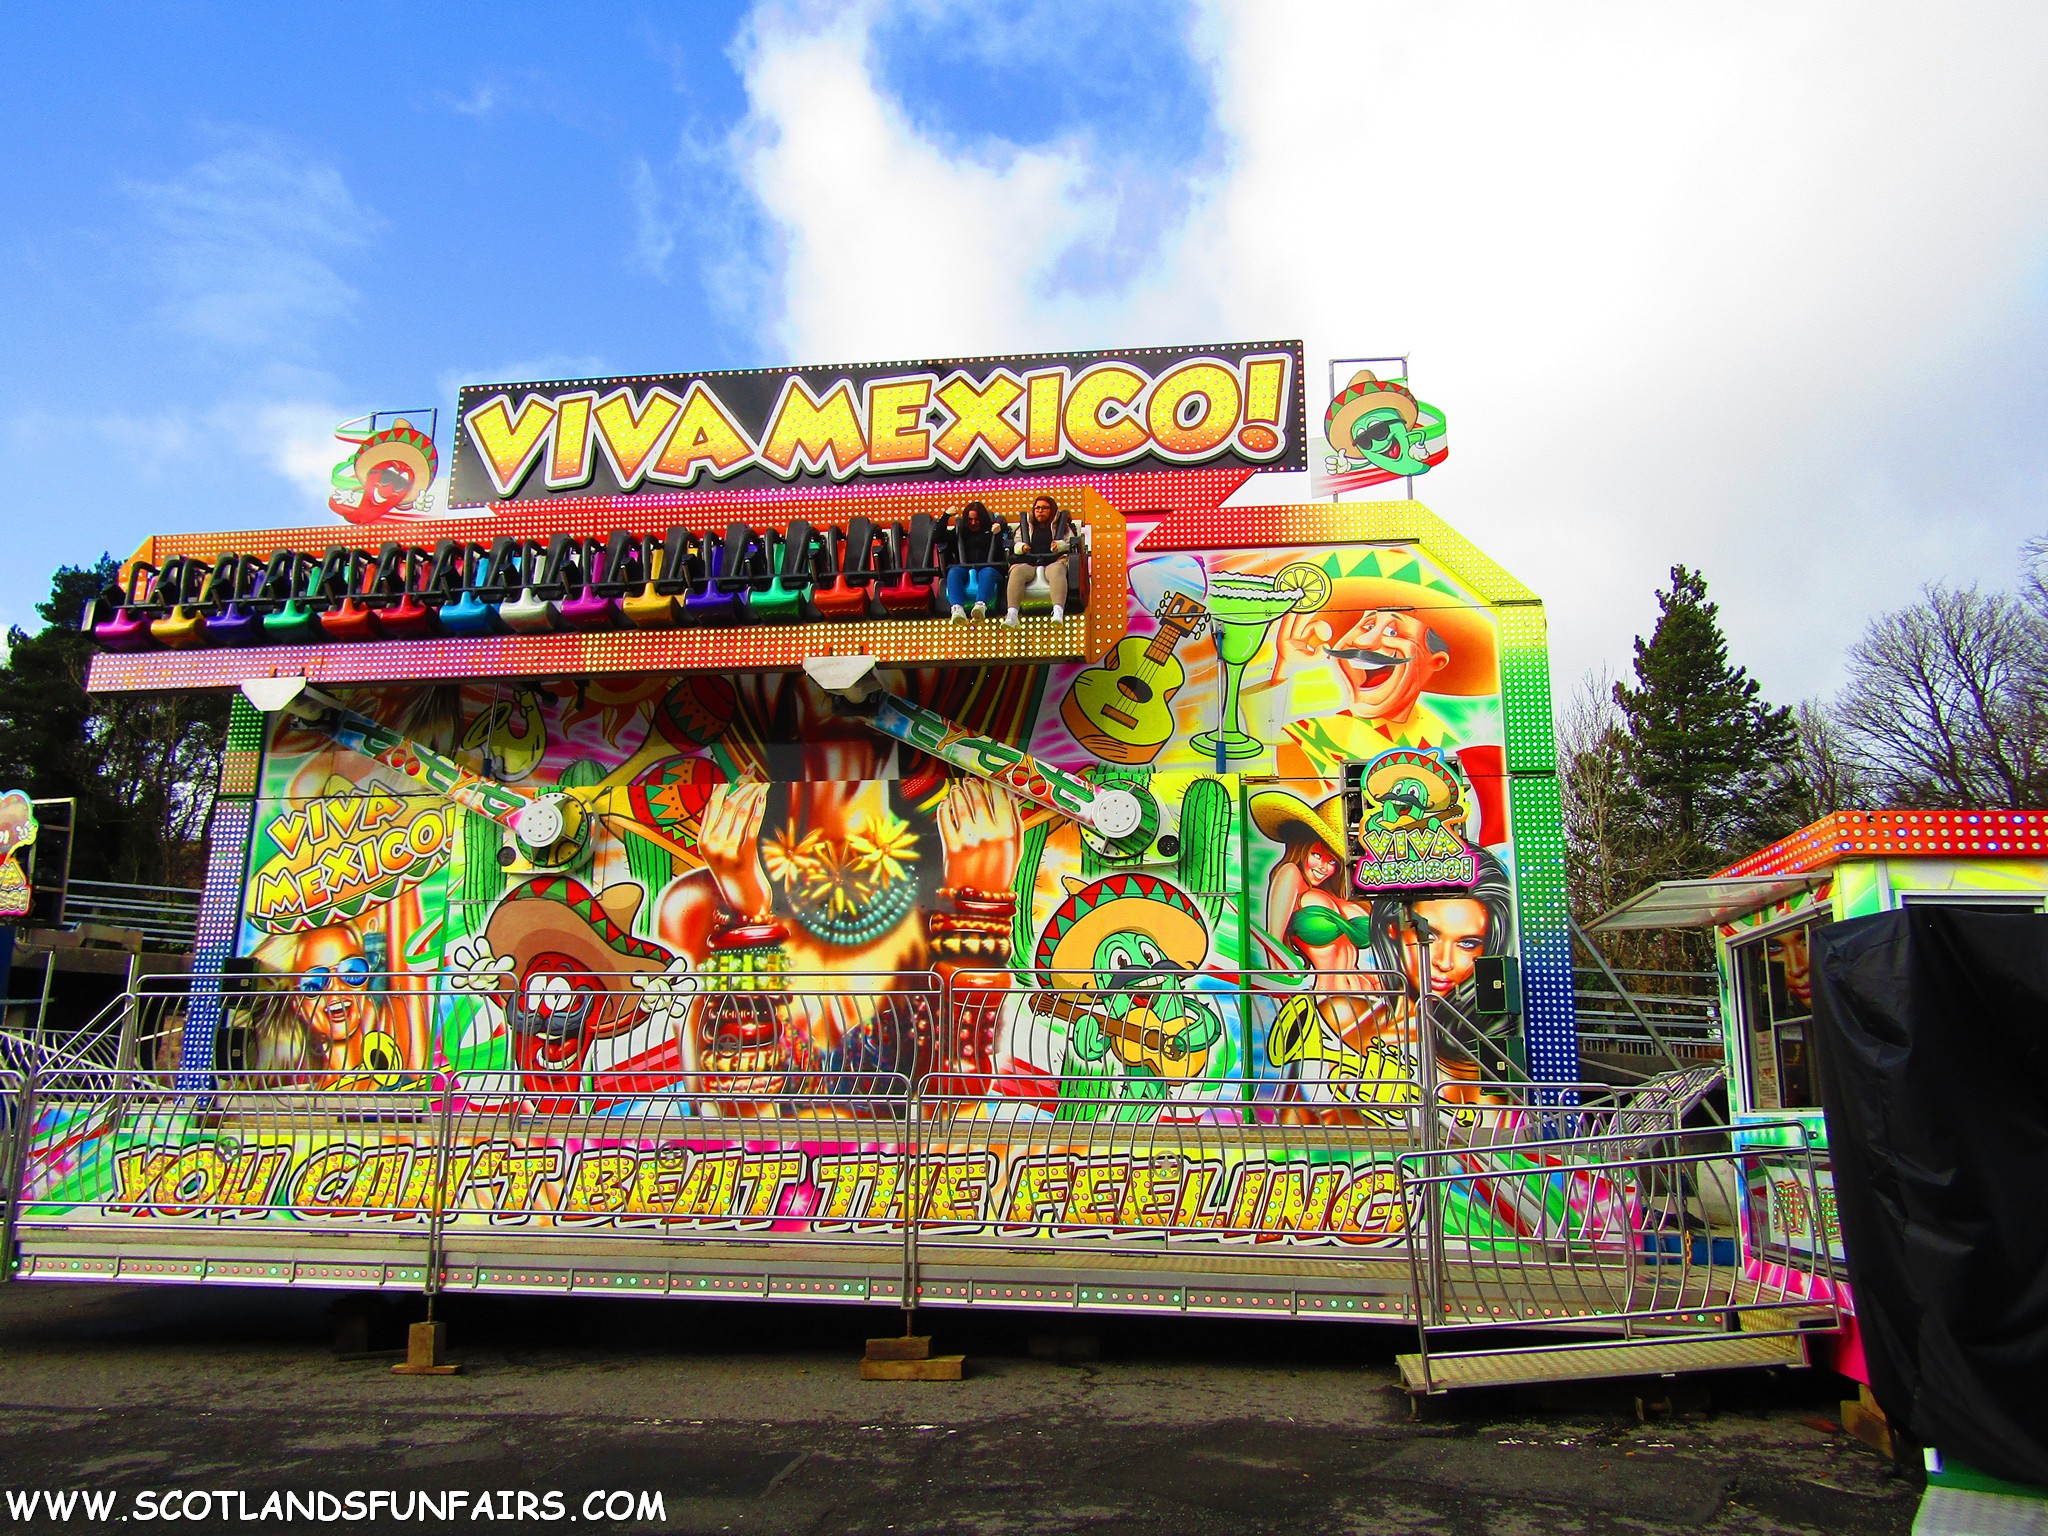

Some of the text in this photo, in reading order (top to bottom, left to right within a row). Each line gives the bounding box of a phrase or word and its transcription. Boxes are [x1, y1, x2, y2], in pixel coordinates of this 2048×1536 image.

[465, 353, 1292, 496] VIVA MEXICO!
[257, 806, 456, 917] MEXICO!
[267, 781, 405, 857] VIVA
[1363, 827, 1463, 862] VIVA
[1359, 856, 1473, 884] MEXICO!
[103, 1142, 291, 1219] YOU
[554, 1147, 806, 1230] BEAT
[811, 1152, 998, 1234] THE
[995, 1154, 1423, 1247] FEELING
